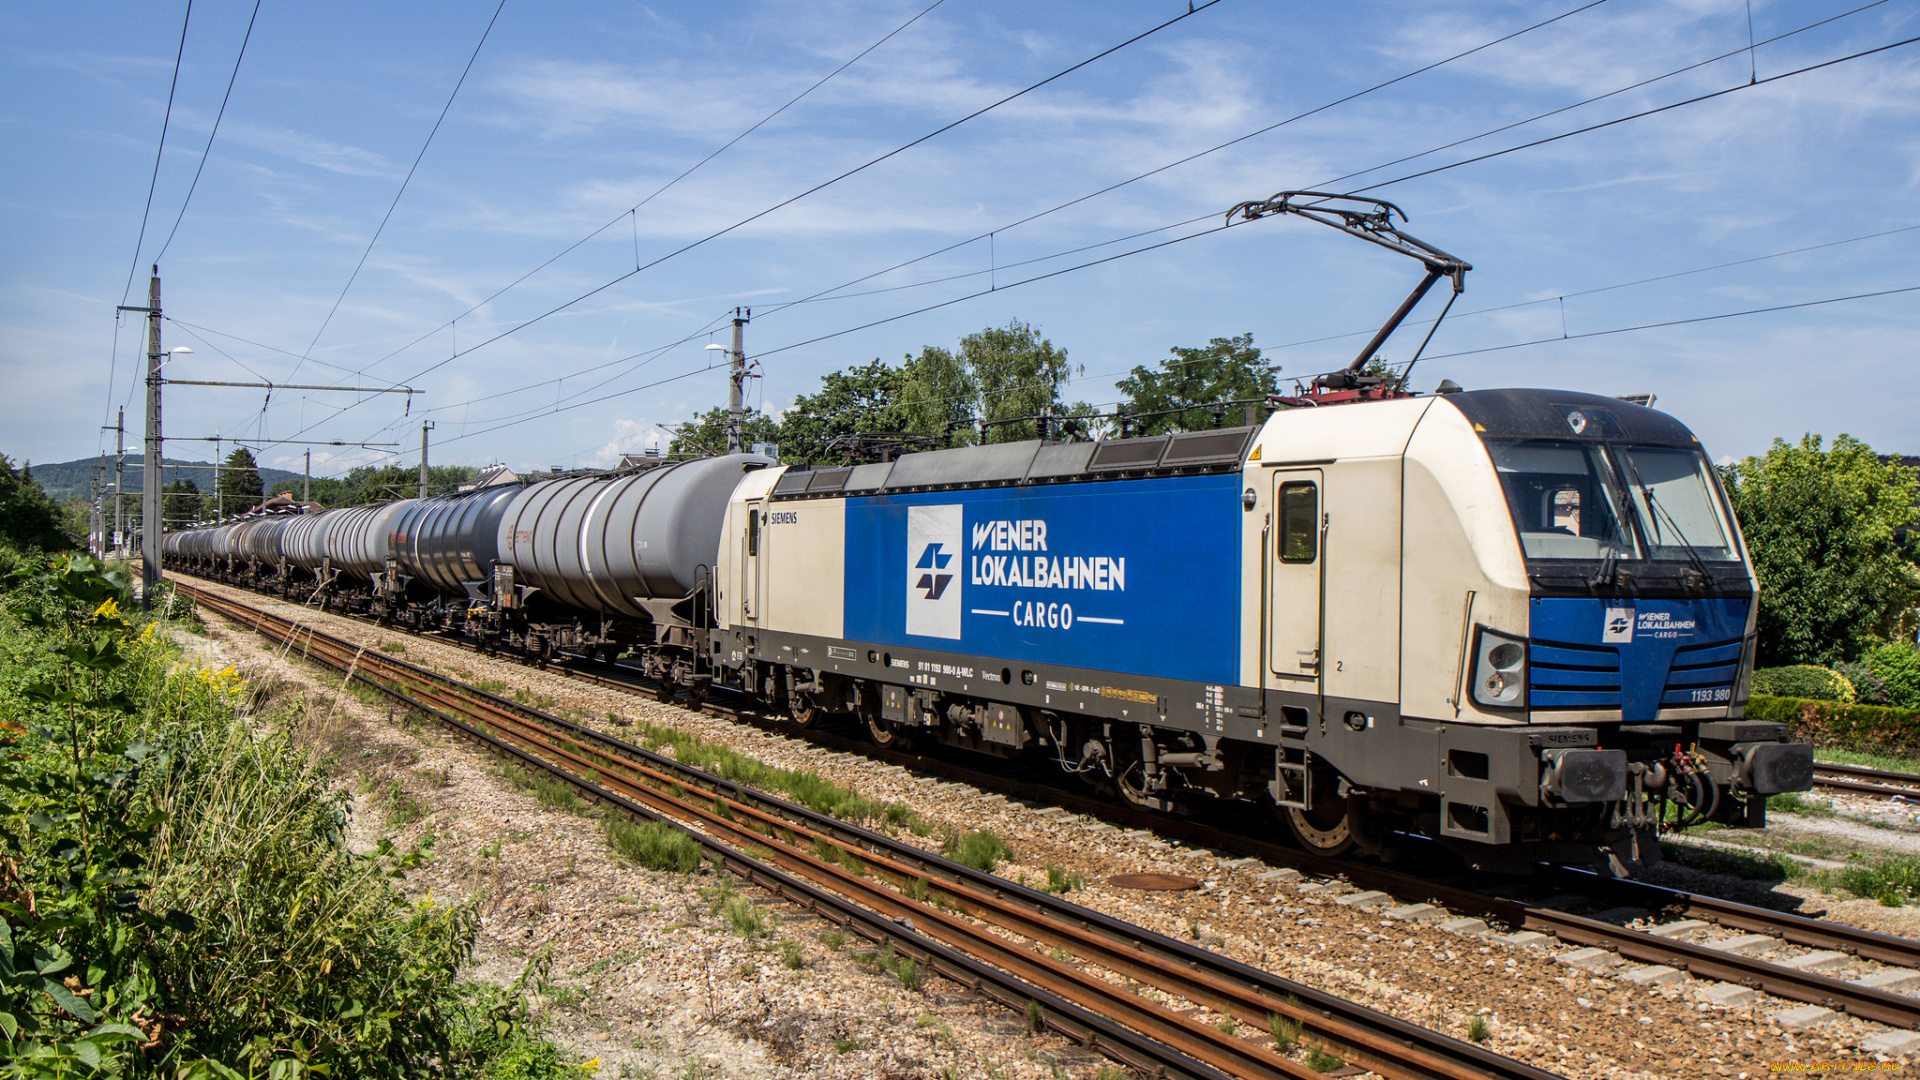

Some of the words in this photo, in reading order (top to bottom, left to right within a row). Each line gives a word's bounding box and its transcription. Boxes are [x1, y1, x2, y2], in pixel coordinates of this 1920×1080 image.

[771, 511, 797, 524] SIEMENS
[972, 519, 1048, 551] WIENER
[971, 555, 1125, 591] LOKALBAHNEN
[1013, 600, 1073, 630] CARGO
[1638, 612, 1670, 621] WIENER
[1637, 620, 1695, 629] LOKALBAHNEN
[1654, 631, 1678, 639] CARGO
[891, 658, 909, 668] SIEMENS
[918, 661, 924, 671] 91
[924, 662, 930, 671] 81
[931, 663, 941, 673] 1193
[1336, 660, 1343, 672] 2
[982, 670, 1001, 682] Vectron
[1691, 690, 1712, 702] 1193
[1714, 689, 1731, 701] 980
[1549, 734, 1589, 743] SIEMENS
